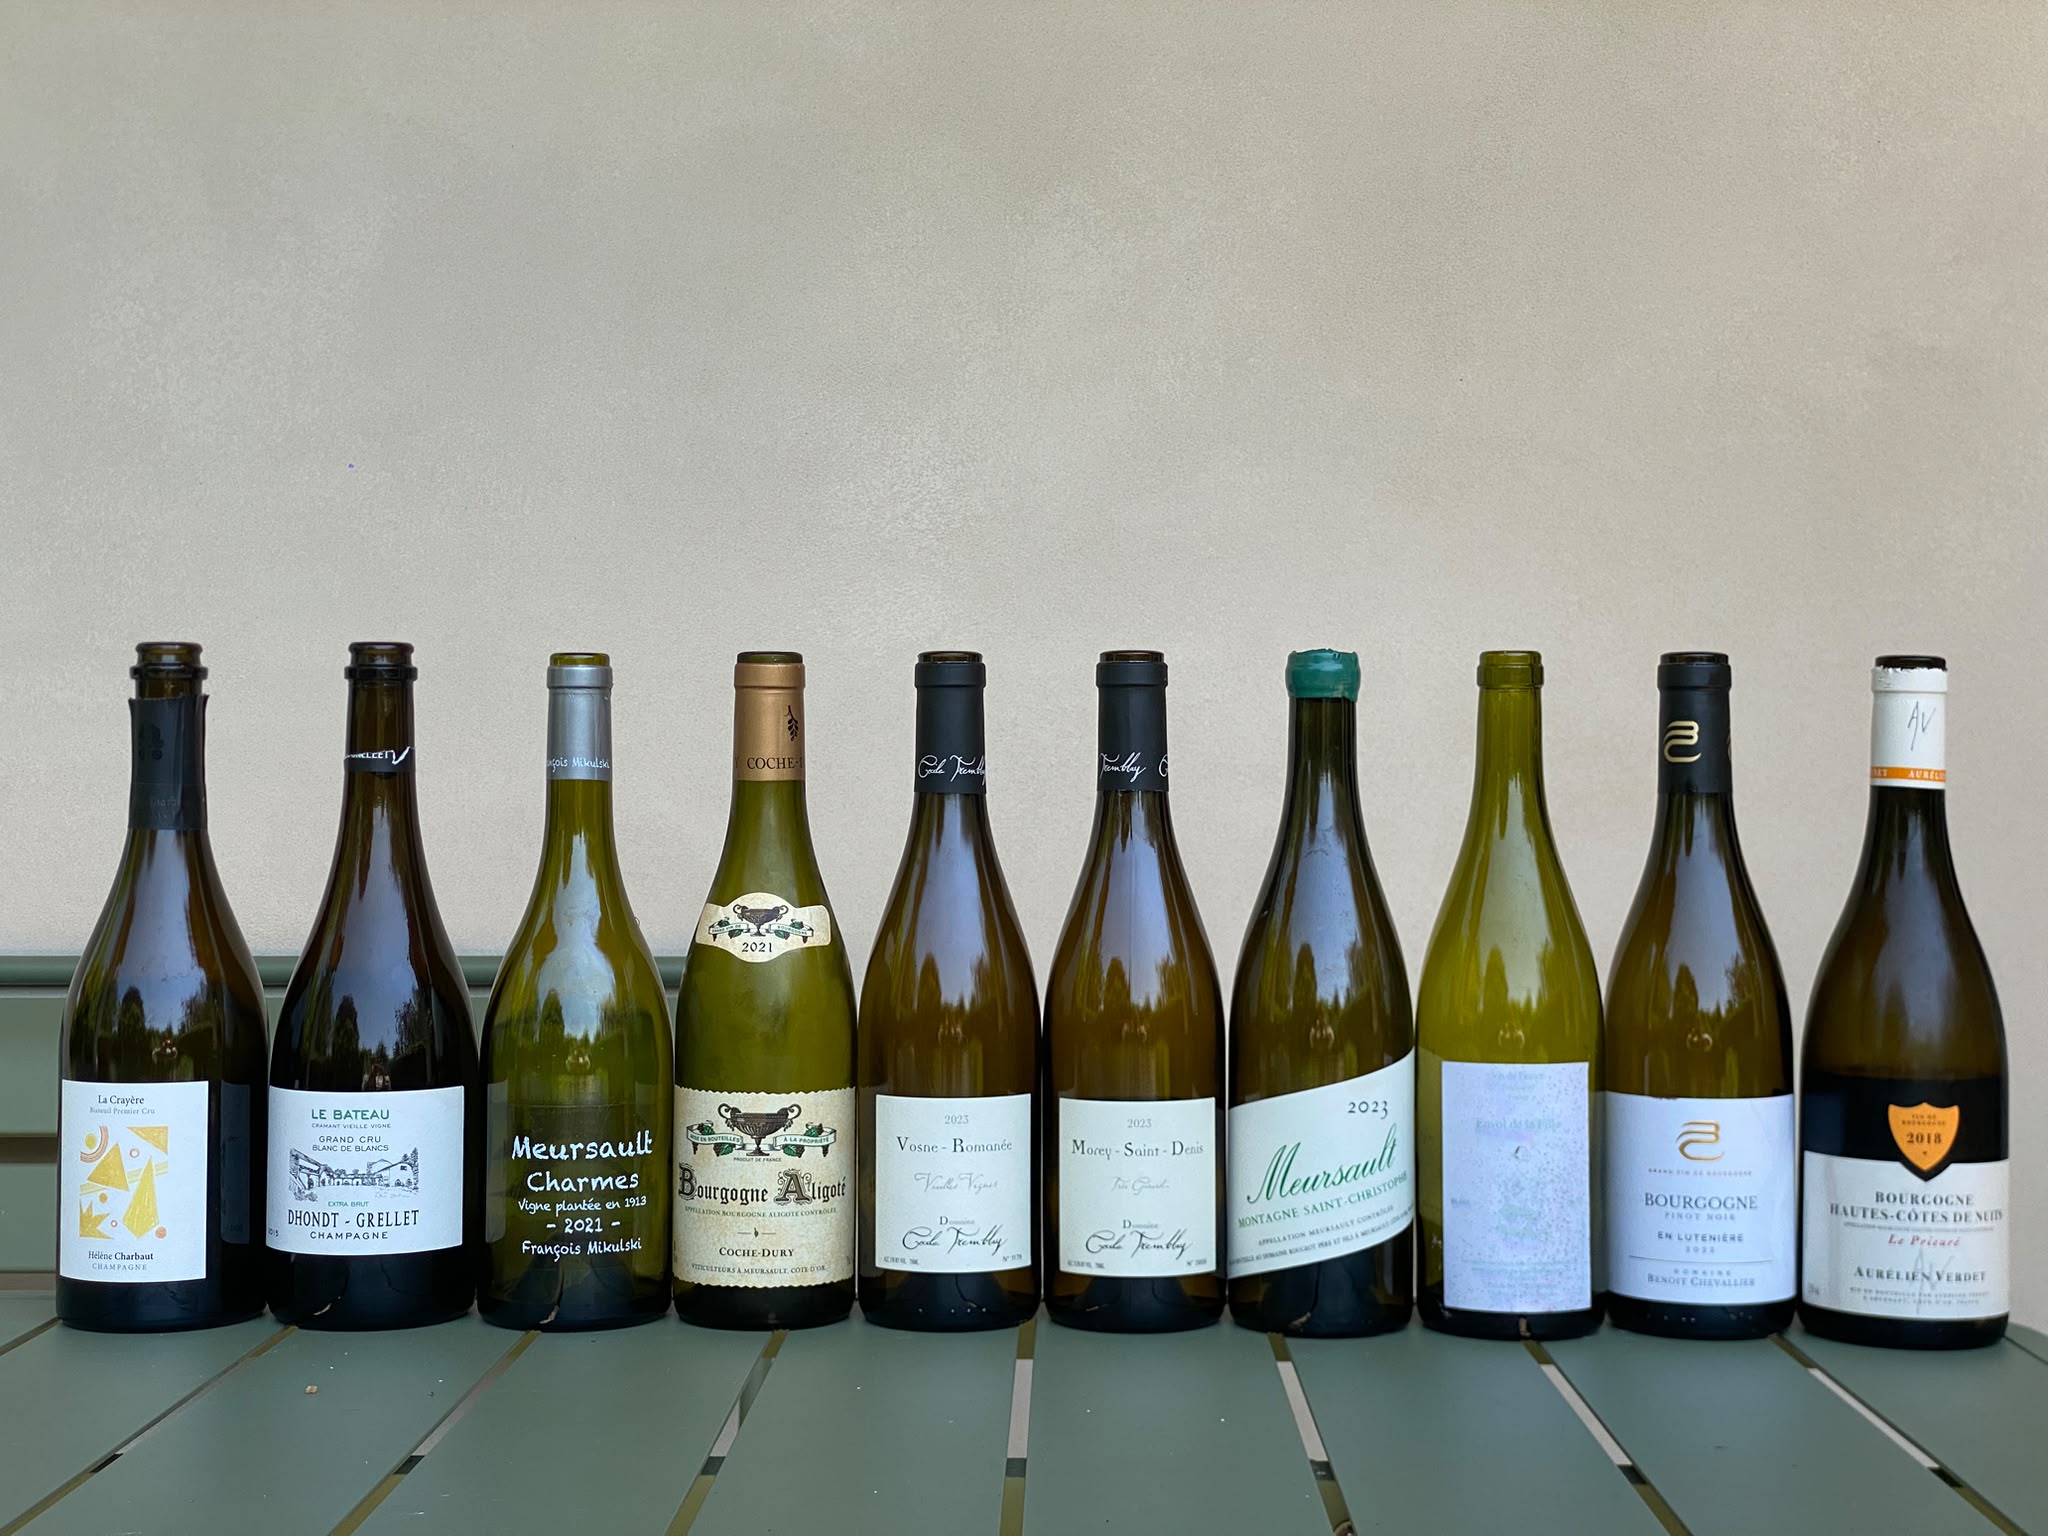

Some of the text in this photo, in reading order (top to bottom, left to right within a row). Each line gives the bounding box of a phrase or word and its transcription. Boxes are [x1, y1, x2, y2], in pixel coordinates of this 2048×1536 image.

[572, 752, 610, 764] Mikulski
[741, 941, 772, 953] 2021
[98, 1094, 145, 1107] La Crayère
[311, 1109, 390, 1120] LE BATEAU
[1347, 1100, 1389, 1120] 2023
[1476, 1118, 1506, 1129] Envol
[1509, 1118, 1521, 1129] de
[1525, 1118, 1535, 1129] la
[319, 1135, 382, 1144] GRAND CRU
[1906, 1132, 1942, 1144] 2018
[312, 1144, 338, 1152] BLANC
[355, 1144, 389, 1152] BLANCS
[511, 1129, 653, 1161] Meursault
[1247, 1123, 1397, 1205] Meursault
[526, 1171, 639, 1192] Charmes
[679, 1162, 846, 1207] Bourgogne Aligoté
[1645, 1192, 1758, 1210] BOURGOGNE
[1875, 1192, 1974, 1206] BOURGOGNE
[518, 1196, 647, 1217] Vigne plantée en 1913
[685, 1205, 720, 1216] APPELLATION
[722, 1210, 766, 1218] BOURGOGNE
[1830, 1203, 1949, 1223] HAUTES-CÔTES
[1953, 1211, 1971, 1223] DE
[288, 1209, 340, 1228] DHONDT
[356, 1209, 420, 1228] GRELLET
[1238, 1208, 1299, 1229] MONTAGNE
[1664, 1211, 1736, 1221] PINOT NOIR
[564, 1217, 603, 1234] 2021
[310, 1231, 389, 1240] CHAMPAGNE
[1258, 1231, 1306, 1246] APPELLATION
[1308, 1219, 1355, 1236] MEURSAULT
[1657, 1231, 1672, 1240] EN
[88, 1250, 154, 1261] Hélène Charbaut
[522, 1237, 642, 1263] François Mikulski
[91, 1262, 147, 1271] CHAMPAGNE
[691, 1263, 736, 1274] VITICULTEURS
[1853, 1266, 1986, 1282] AURÉLIEN VERDET
